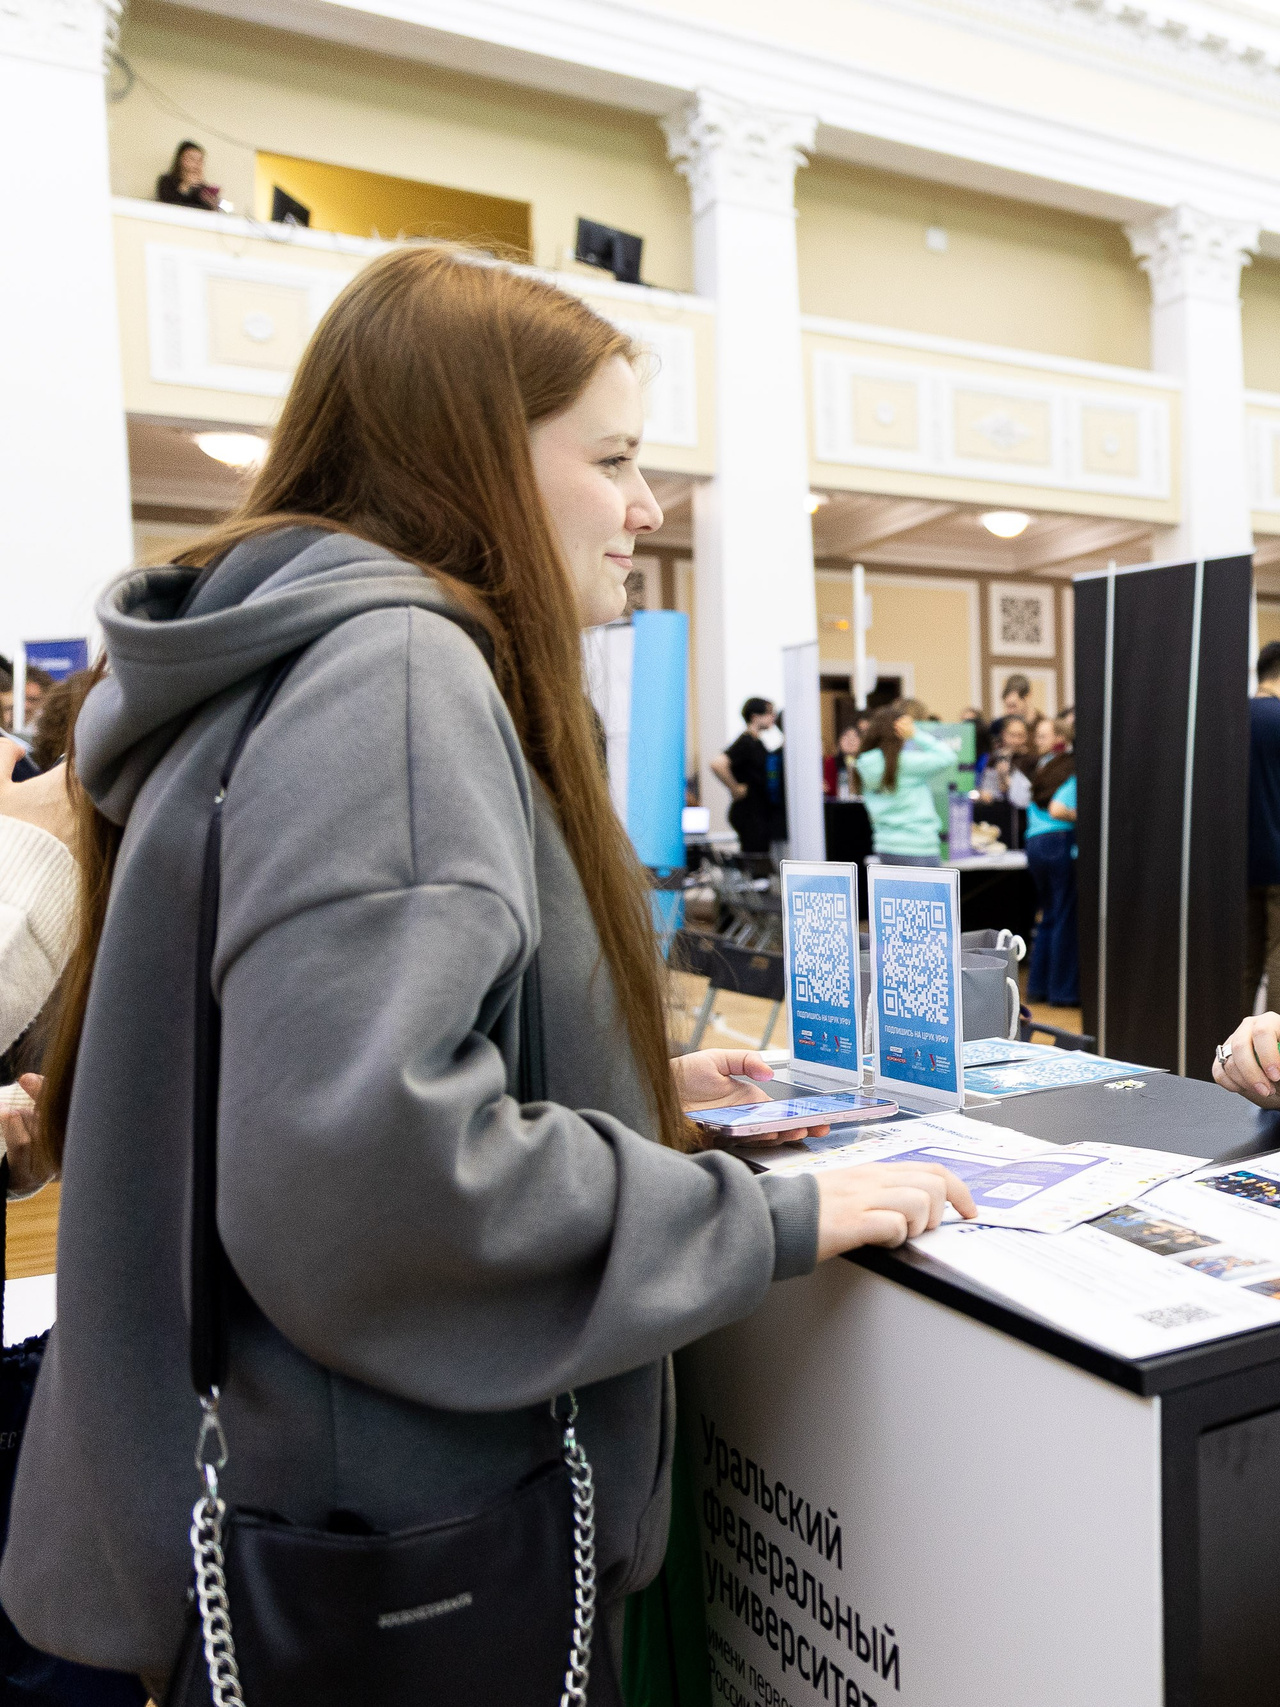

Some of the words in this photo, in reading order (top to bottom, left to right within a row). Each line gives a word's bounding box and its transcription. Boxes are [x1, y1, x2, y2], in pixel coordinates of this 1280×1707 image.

[700, 1412, 843, 1572] Уральский
[702, 1487, 901, 1691] федеральный
[707, 1624, 746, 1680] имени
